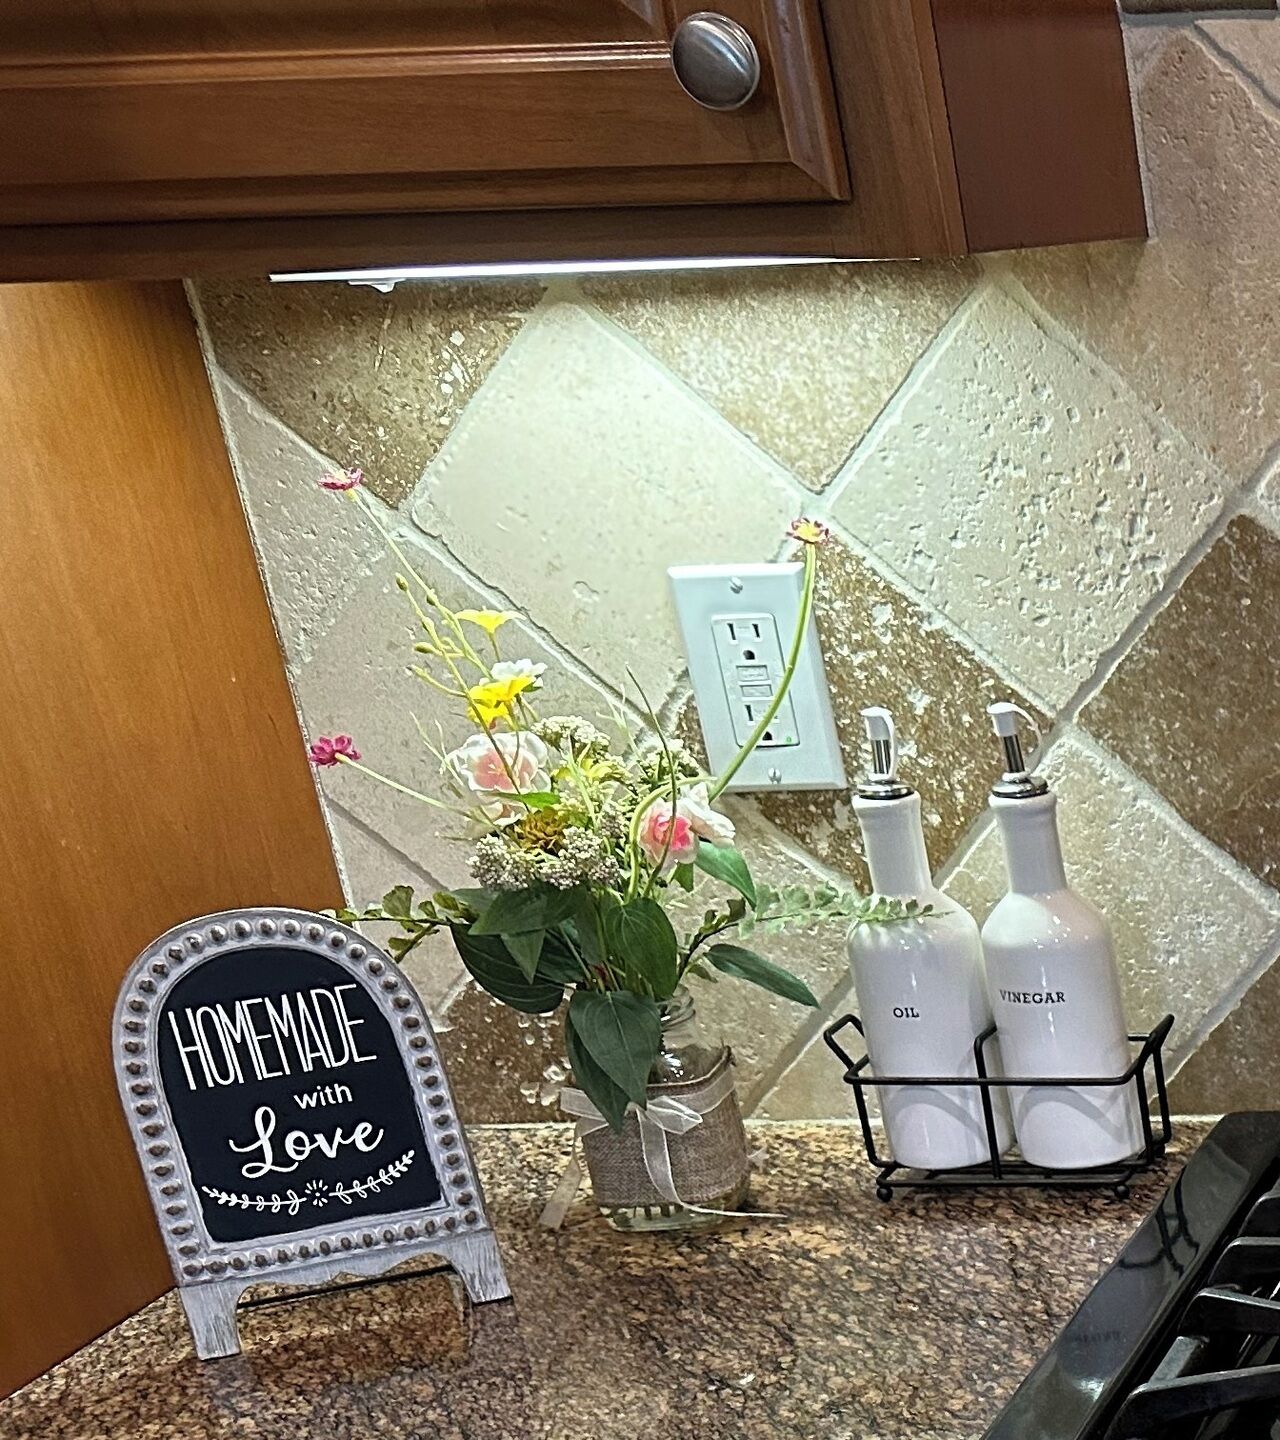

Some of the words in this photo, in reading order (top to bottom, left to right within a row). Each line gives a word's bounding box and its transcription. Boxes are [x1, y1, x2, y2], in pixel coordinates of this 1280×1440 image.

[999, 989, 1066, 1004] VINEGAR
[892, 1007, 920, 1018] OIL
[168, 983, 378, 1091] HOMEMADE
[293, 1083, 353, 1110] with
[229, 1106, 385, 1179] Love
